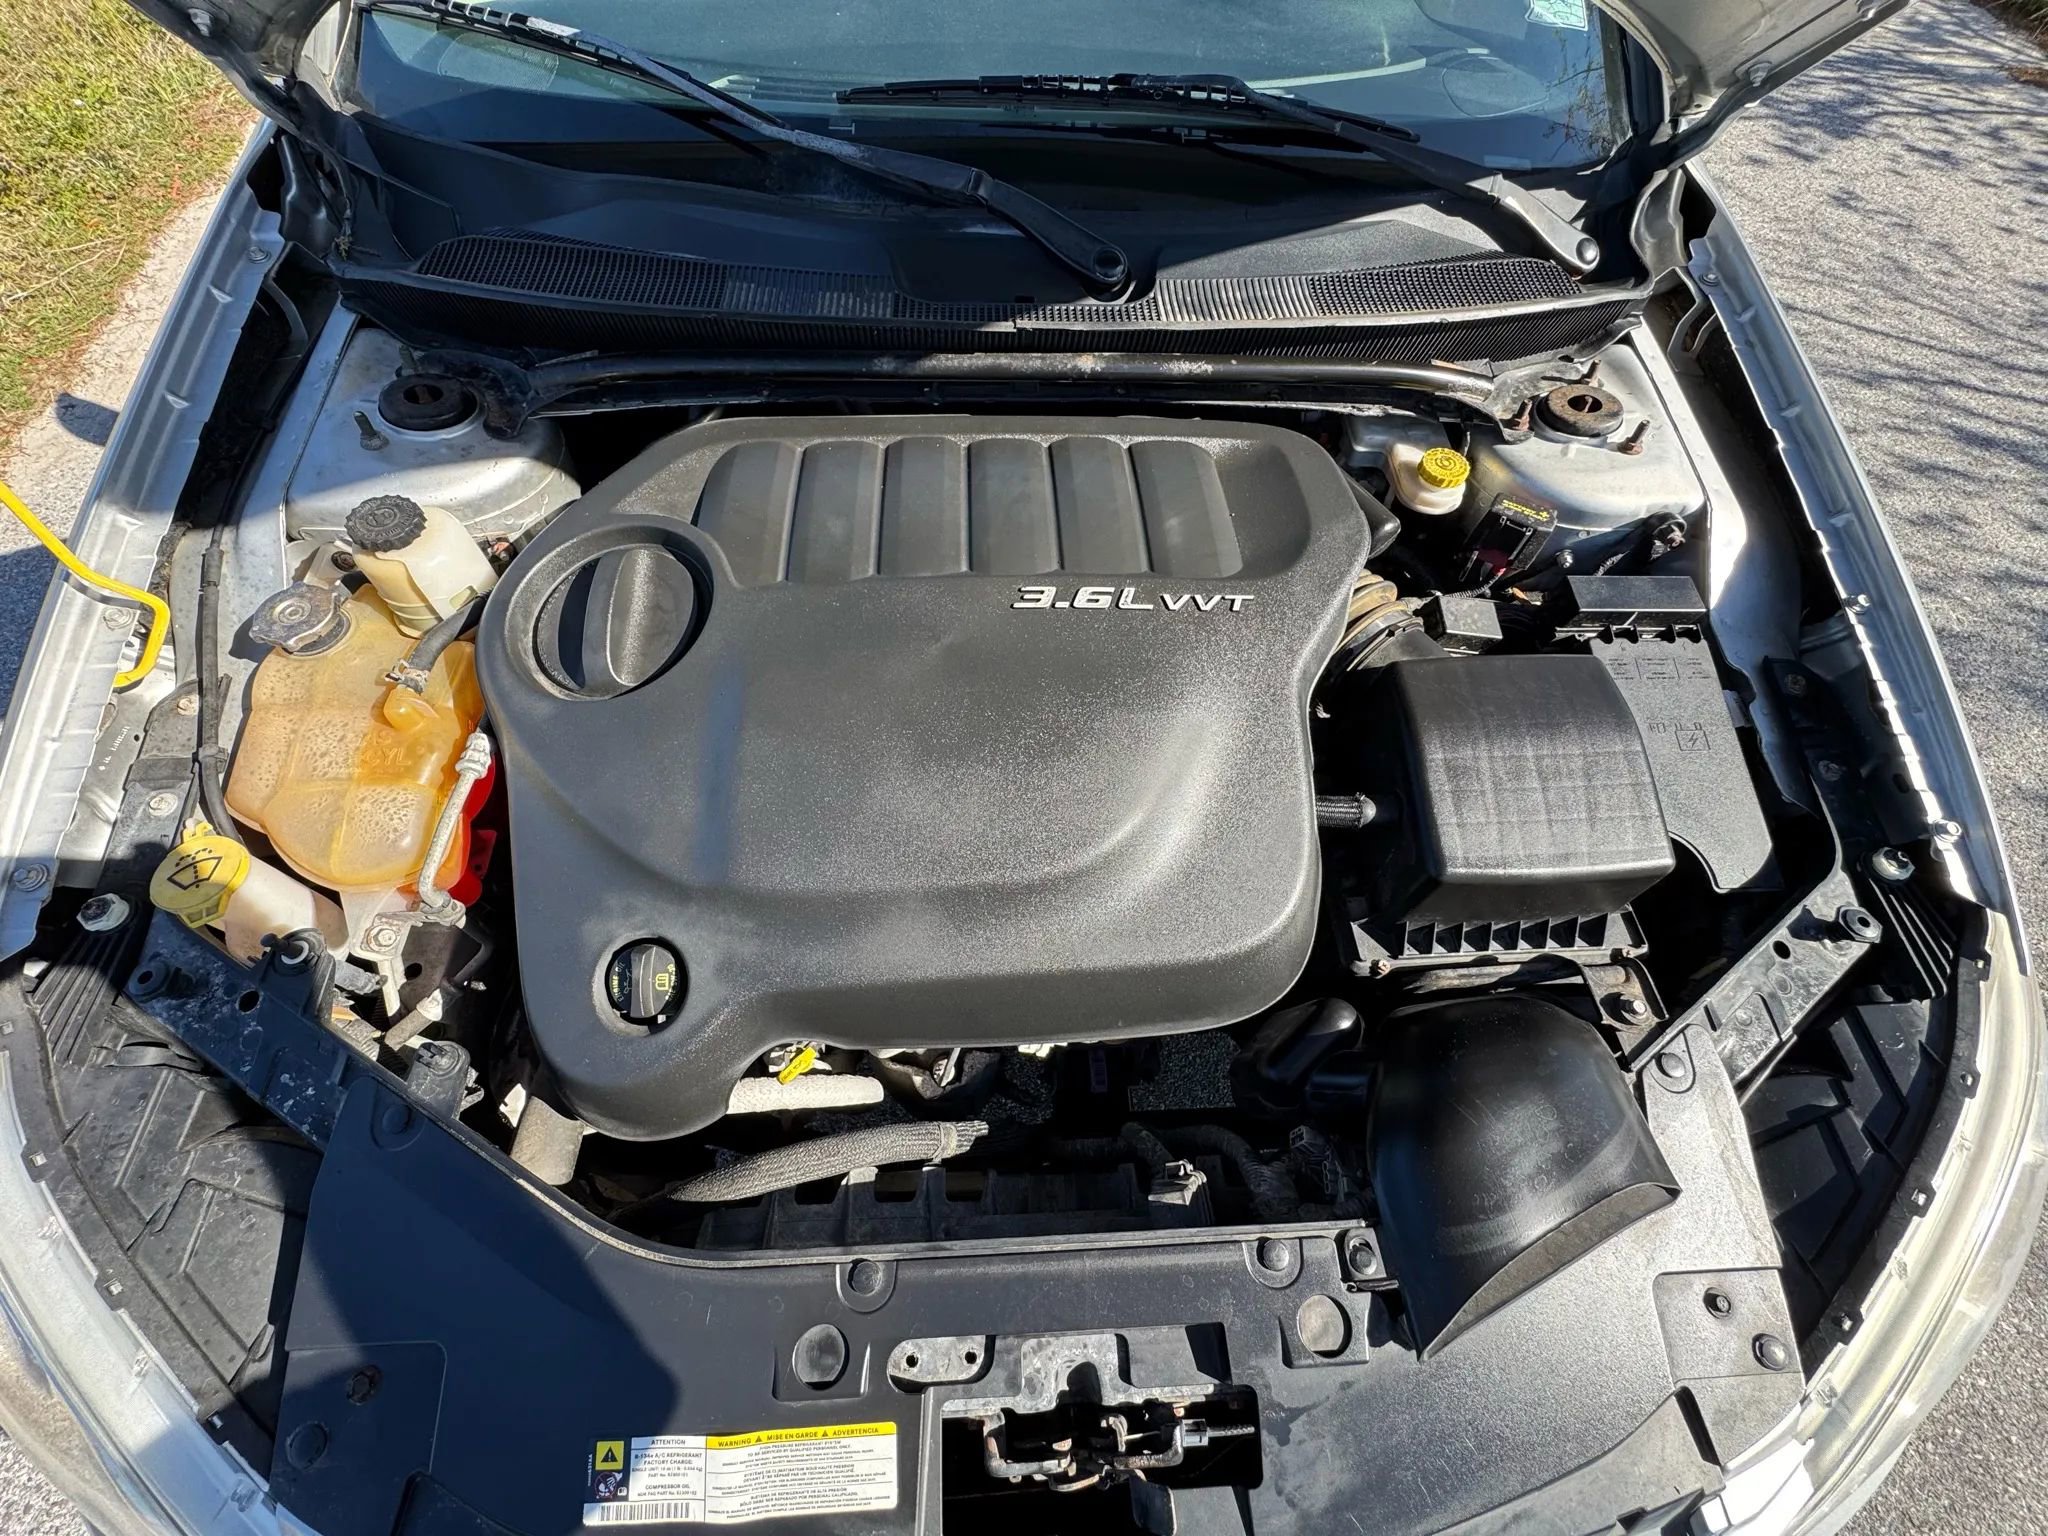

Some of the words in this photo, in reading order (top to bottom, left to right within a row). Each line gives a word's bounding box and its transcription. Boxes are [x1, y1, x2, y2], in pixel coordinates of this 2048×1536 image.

[1011, 586, 1154, 610] 3.6L
[1160, 594, 1255, 611] VVT
[614, 961, 625, 973] OIL
[612, 974, 624, 1002] ENGINE
[718, 1438, 752, 1447] WARNING
[766, 1433, 784, 1441] MISE
[795, 1431, 818, 1439] GARDE
[832, 1427, 879, 1436] ADVERTENCIA
